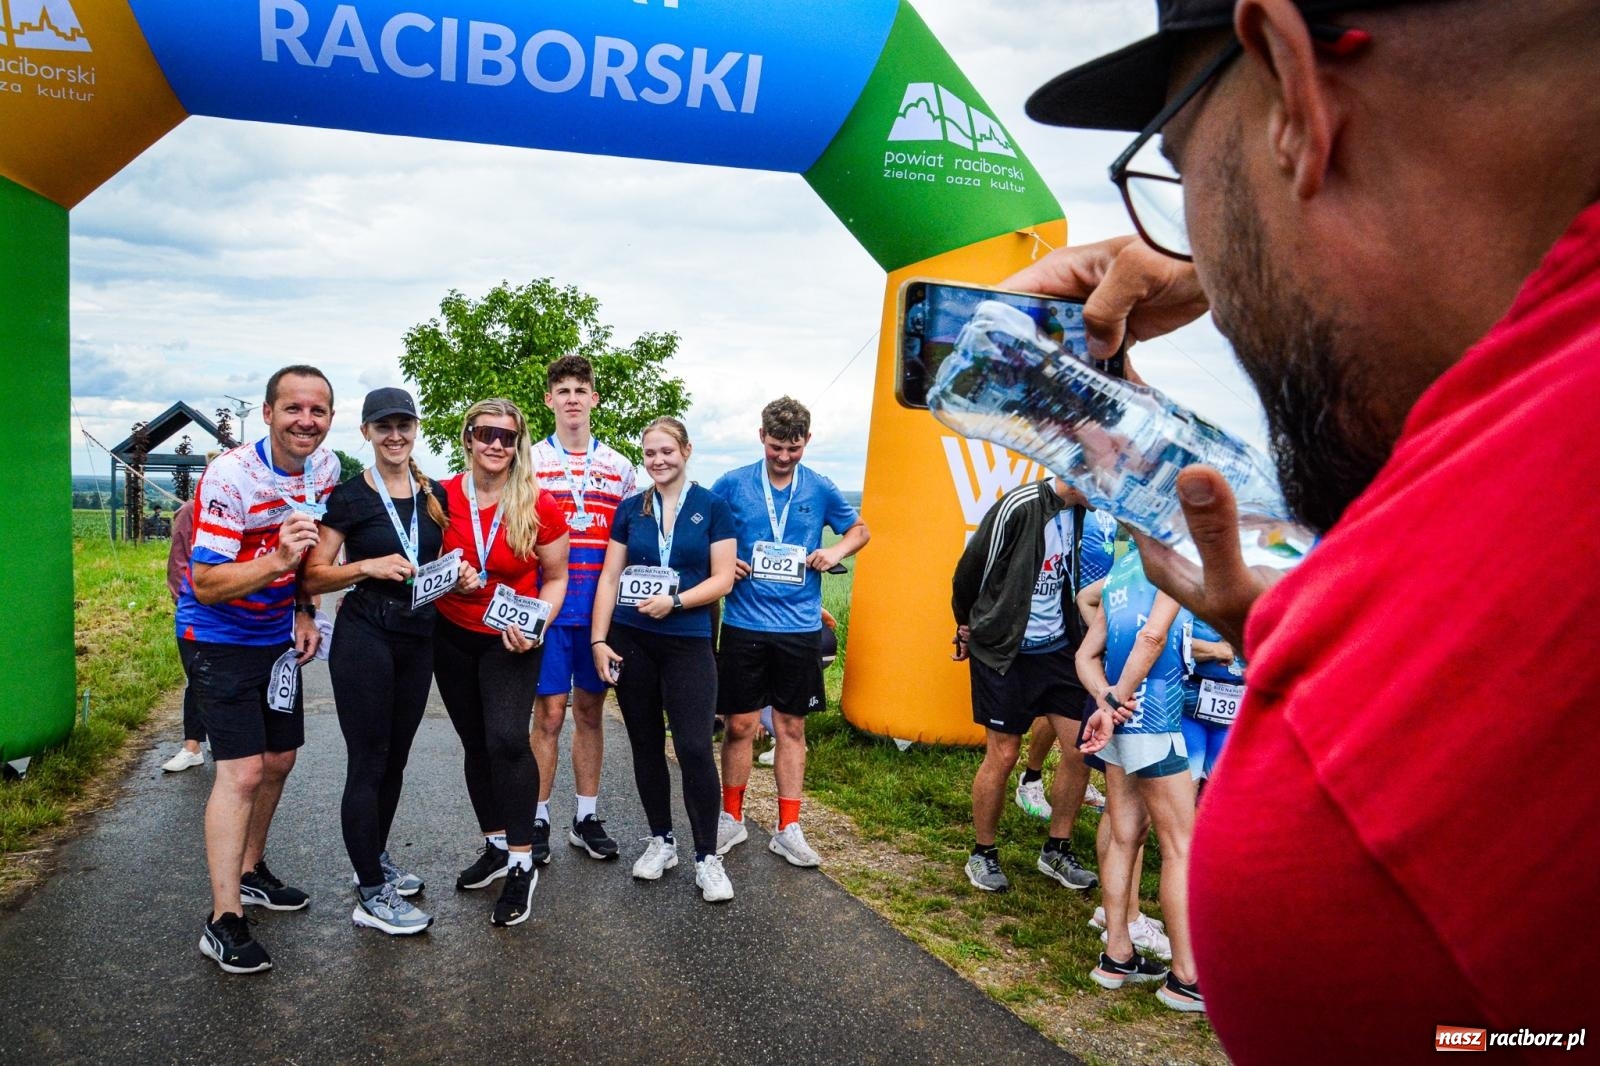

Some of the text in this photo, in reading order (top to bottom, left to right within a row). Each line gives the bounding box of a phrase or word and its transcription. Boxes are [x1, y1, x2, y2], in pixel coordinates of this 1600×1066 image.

[259, 0, 763, 114] RACIBORSKI
[37, 83, 95, 102] kultur
[884, 150, 1025, 182] powiat raciborski
[883, 167, 1026, 193] zielona oaza kultur
[761, 556, 793, 572] 082
[423, 569, 452, 593] 024
[630, 579, 663, 596] 032
[498, 602, 530, 627] 029
[279, 662, 292, 699] 027
[1210, 697, 1237, 716] 139
